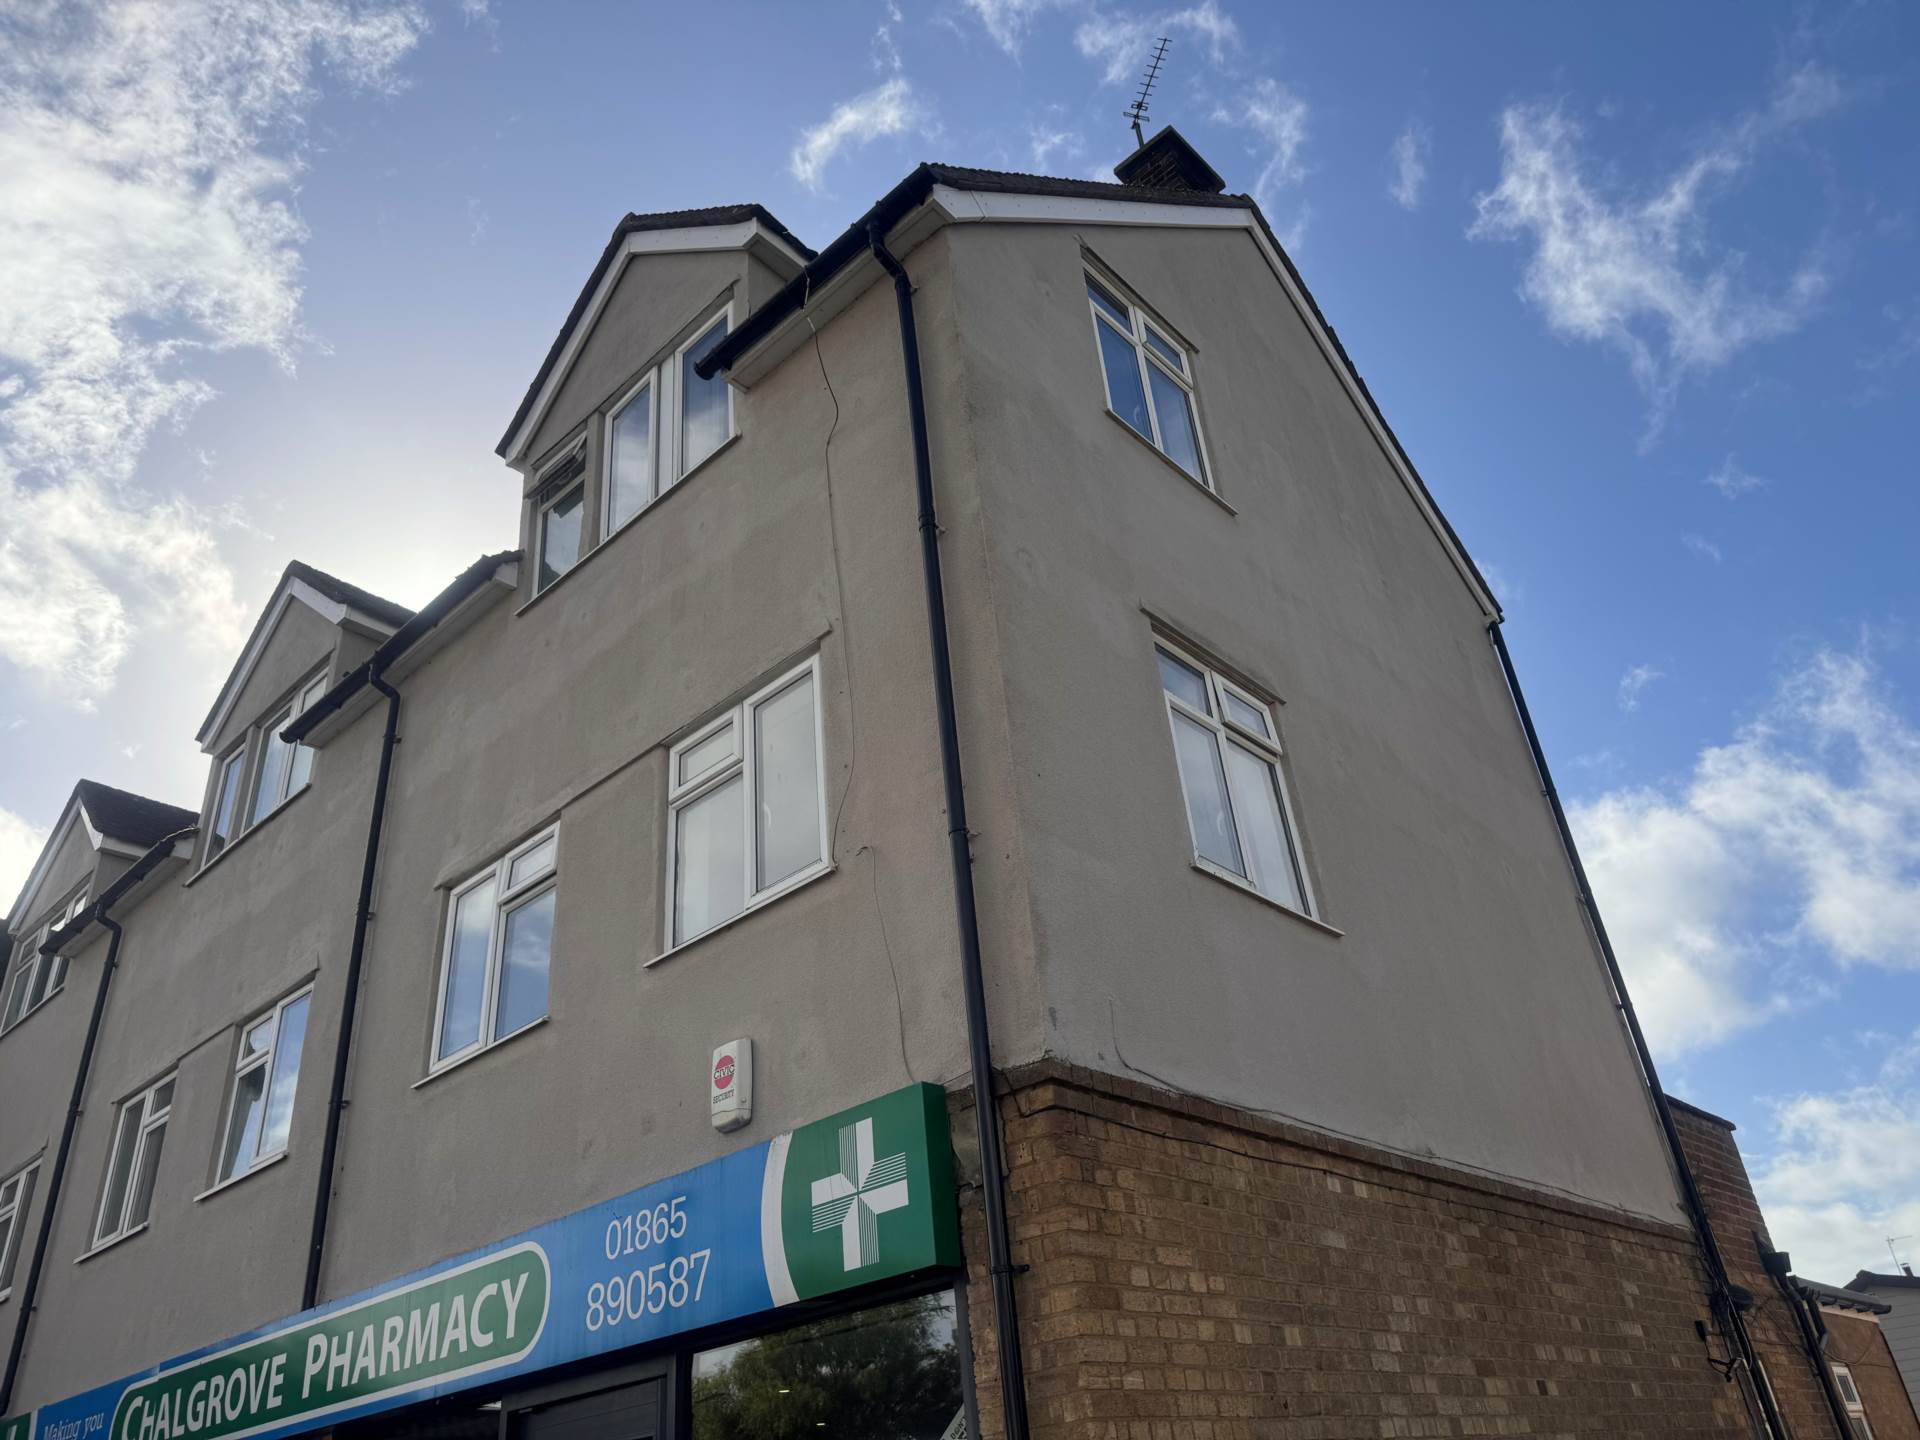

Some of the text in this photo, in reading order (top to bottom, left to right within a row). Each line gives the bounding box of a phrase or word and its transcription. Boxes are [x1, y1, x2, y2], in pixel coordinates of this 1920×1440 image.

[713, 1064, 735, 1080] CIVIC
[605, 1196, 686, 1260] 01865
[585, 1248, 711, 1331] 890587
[121, 1272, 529, 1440] CHALGROVE PHARMACY
[83, 1413, 104, 1440] you
